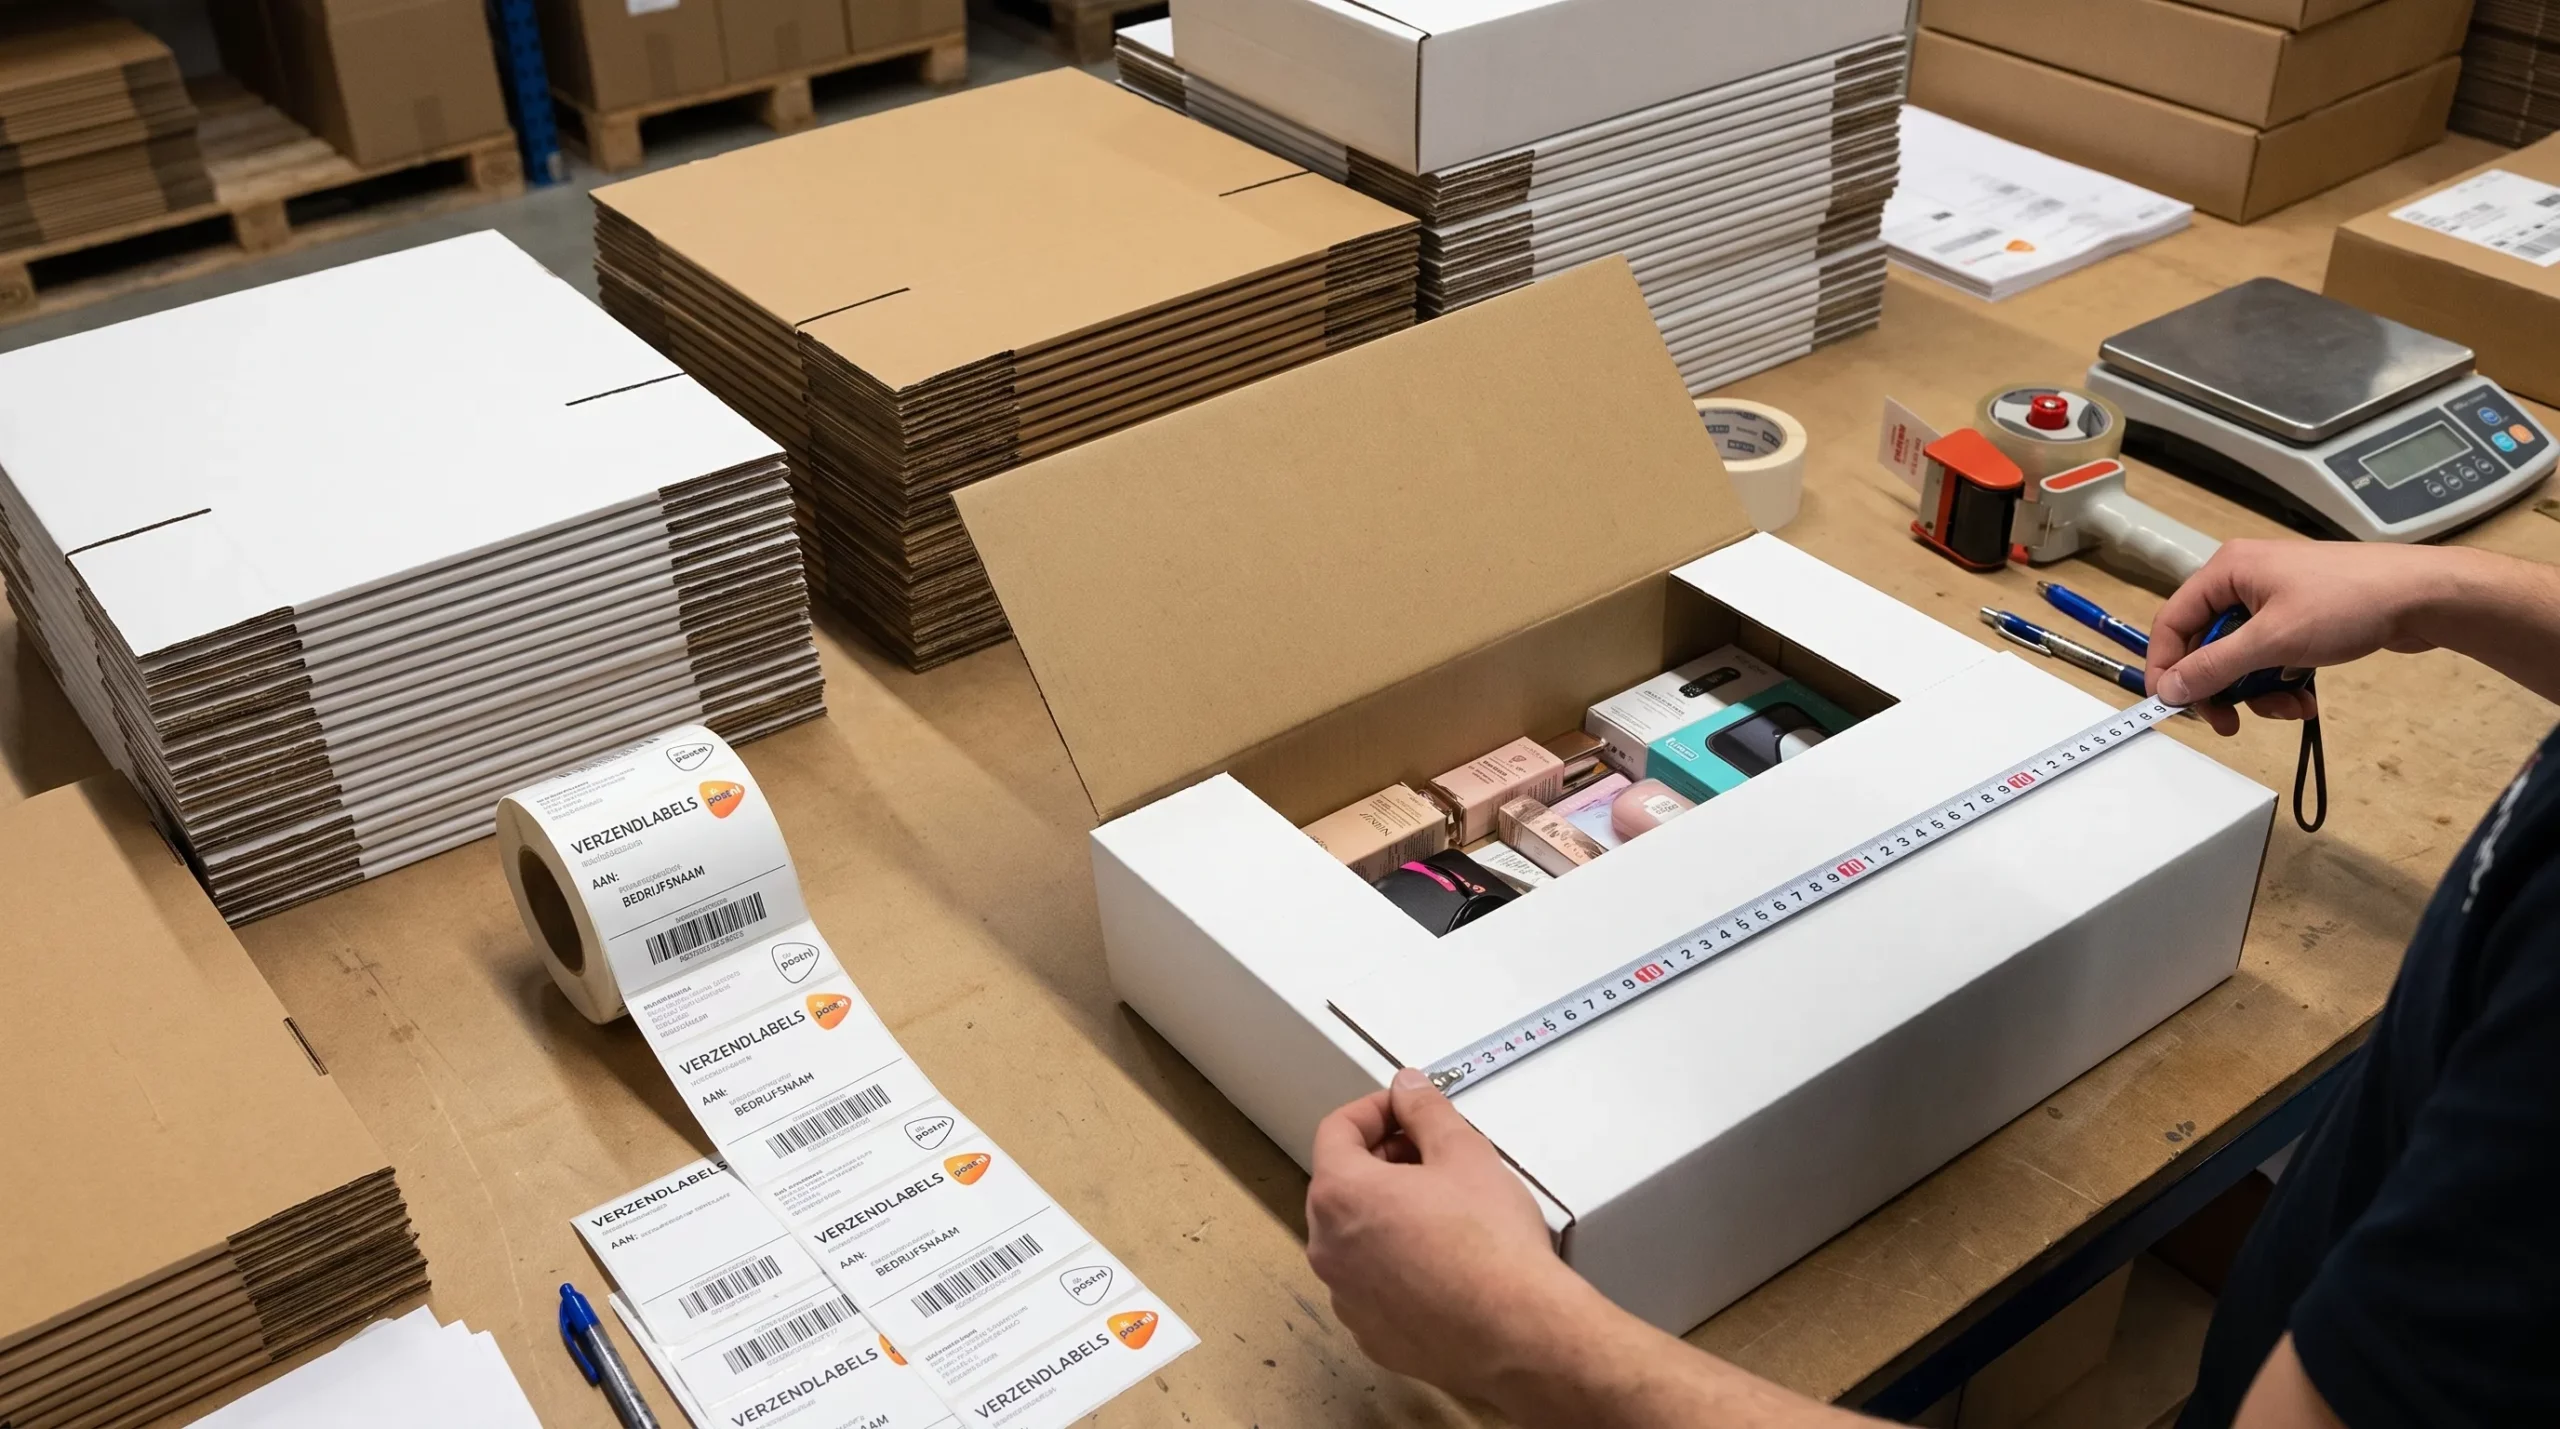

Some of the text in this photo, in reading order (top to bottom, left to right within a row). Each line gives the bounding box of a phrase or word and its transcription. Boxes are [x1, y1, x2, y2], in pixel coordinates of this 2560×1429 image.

[571, 796, 699, 855] VERZENDLABELS
[592, 872, 620, 890] AAN:
[621, 865, 706, 908] BEDRIJFSNAAM
[1462, 1062, 1476, 1074] 2
[1482, 1052, 1495, 1063] 3
[1505, 1042, 1516, 1051] 4
[1525, 1031, 1536, 1041] 4
[1543, 1019, 1557, 1031] 5
[1564, 1010, 1577, 1020] 6
[1583, 999, 1595, 1010] 7
[1603, 989, 1616, 1000] 8
[1622, 979, 1636, 990] 9
[1638, 966, 1661, 980] 10
[1663, 960, 1674, 968] 1
[1681, 949, 1694, 960] 2
[1699, 940, 1712, 950] 3
[1719, 929, 1731, 939] 4
[1735, 919, 1750, 930] 5
[1755, 910, 1768, 920] 5
[1773, 901, 1786, 911] 6
[1790, 891, 1802, 901] 7
[1809, 882, 1822, 892] 8
[1826, 873, 1840, 883] 9
[1880, 846, 1894, 856] 2
[1897, 837, 1910, 847] 3
[1915, 828, 1927, 838] 4
[1930, 820, 1942, 829] 5
[1948, 811, 1961, 821] 6
[1964, 802, 1976, 812] 7
[1981, 794, 1994, 803] 8
[1998, 785, 2010, 794] 9
[2062, 752, 2075, 760] 3
[2109, 728, 2122, 736] 6
[2124, 720, 2134, 728] 7
[2139, 712, 2152, 720] 8
[2154, 705, 2166, 713] 9
[679, 1009, 806, 1076] VERZENDLABELS
[702, 1088, 729, 1106] AAN:
[591, 1160, 729, 1229] VERZENDLABELS
[813, 1172, 945, 1245] VERZENDLABELS
[610, 1233, 639, 1250] AAN:
[840, 1251, 868, 1270] AAN:
[1072, 1269, 1108, 1296] postnl
[730, 1347, 879, 1428] VERZENDLABELS
[974, 1333, 1110, 1419] VERZENDLABELS
